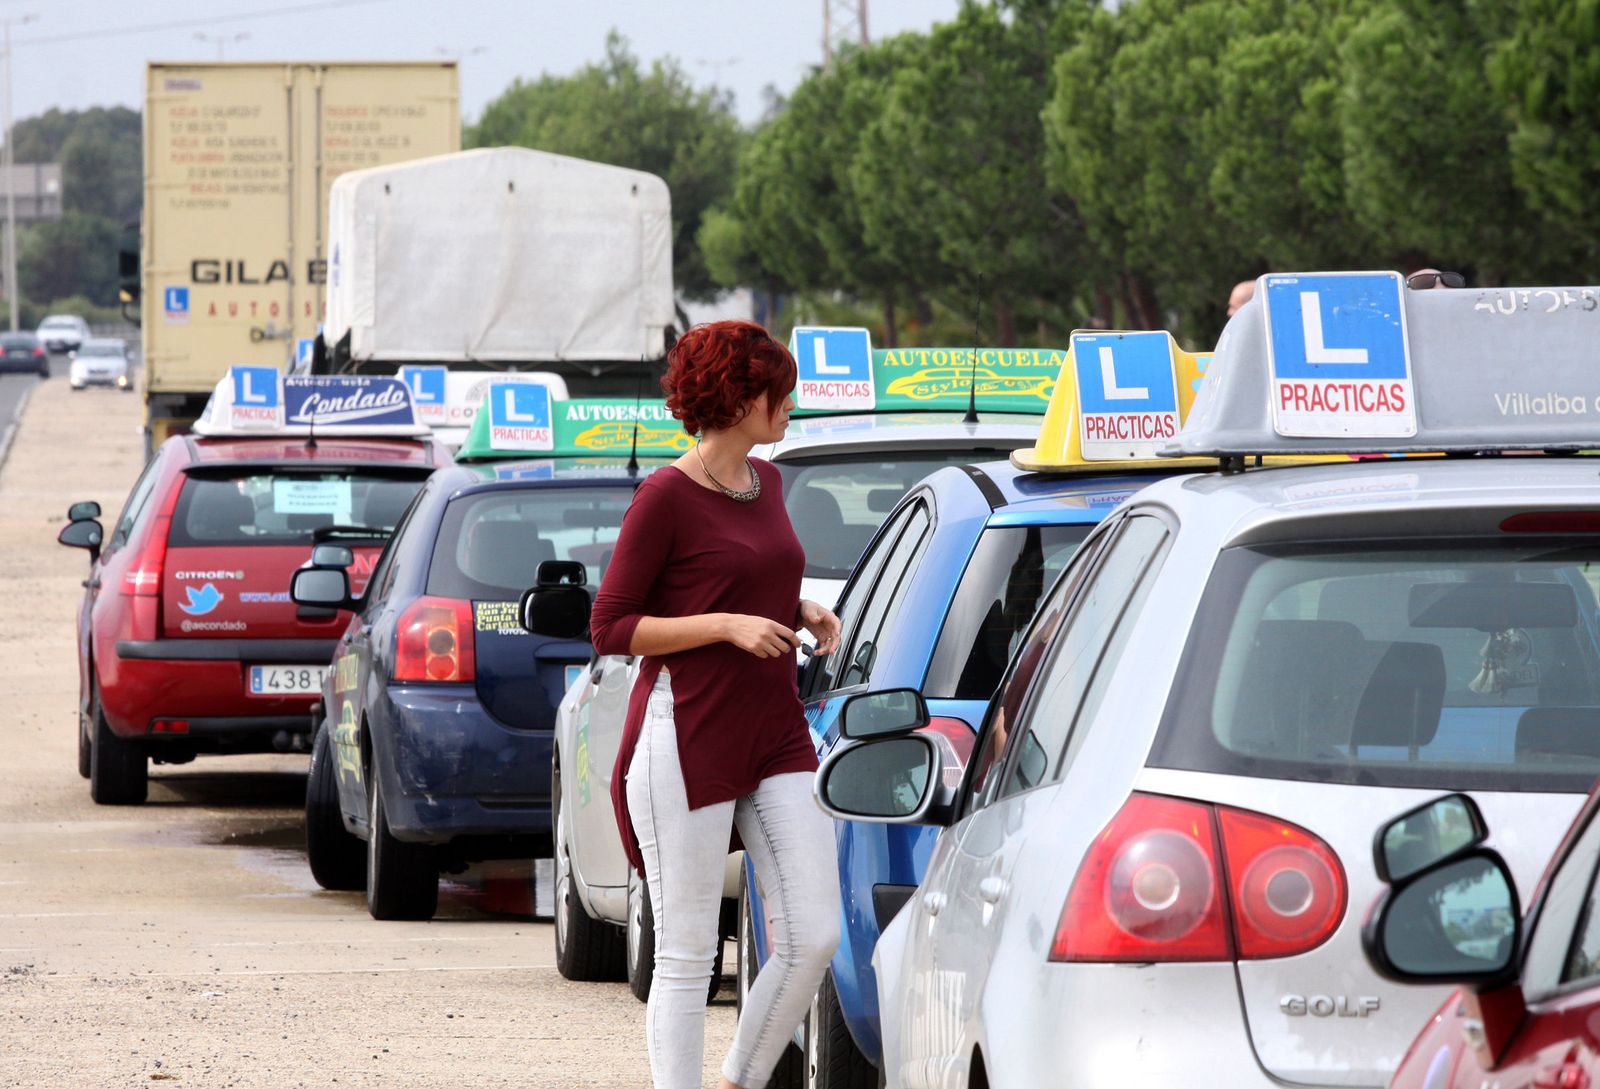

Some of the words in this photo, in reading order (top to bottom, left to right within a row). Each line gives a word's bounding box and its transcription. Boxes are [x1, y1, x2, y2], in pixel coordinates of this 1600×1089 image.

[1300, 291, 1369, 364] L
[814, 337, 850, 374] L
[883, 350, 1063, 366] AUTOESCUELA
[413, 373, 435, 400] L
[1099, 346, 1149, 400] L
[243, 371, 267, 403] L
[299, 384, 405, 417] Condado
[802, 383, 870, 399] PRACTICAS
[1280, 383, 1406, 413] PRACTICAS
[232, 407, 278, 421] PRACTICAS
[504, 389, 535, 422] L
[1494, 393, 1587, 416] Villalba
[493, 427, 548, 443] PRACTICAS
[1086, 414, 1176, 440] PRACTICAS
[1279, 994, 1381, 1018] GOLF
